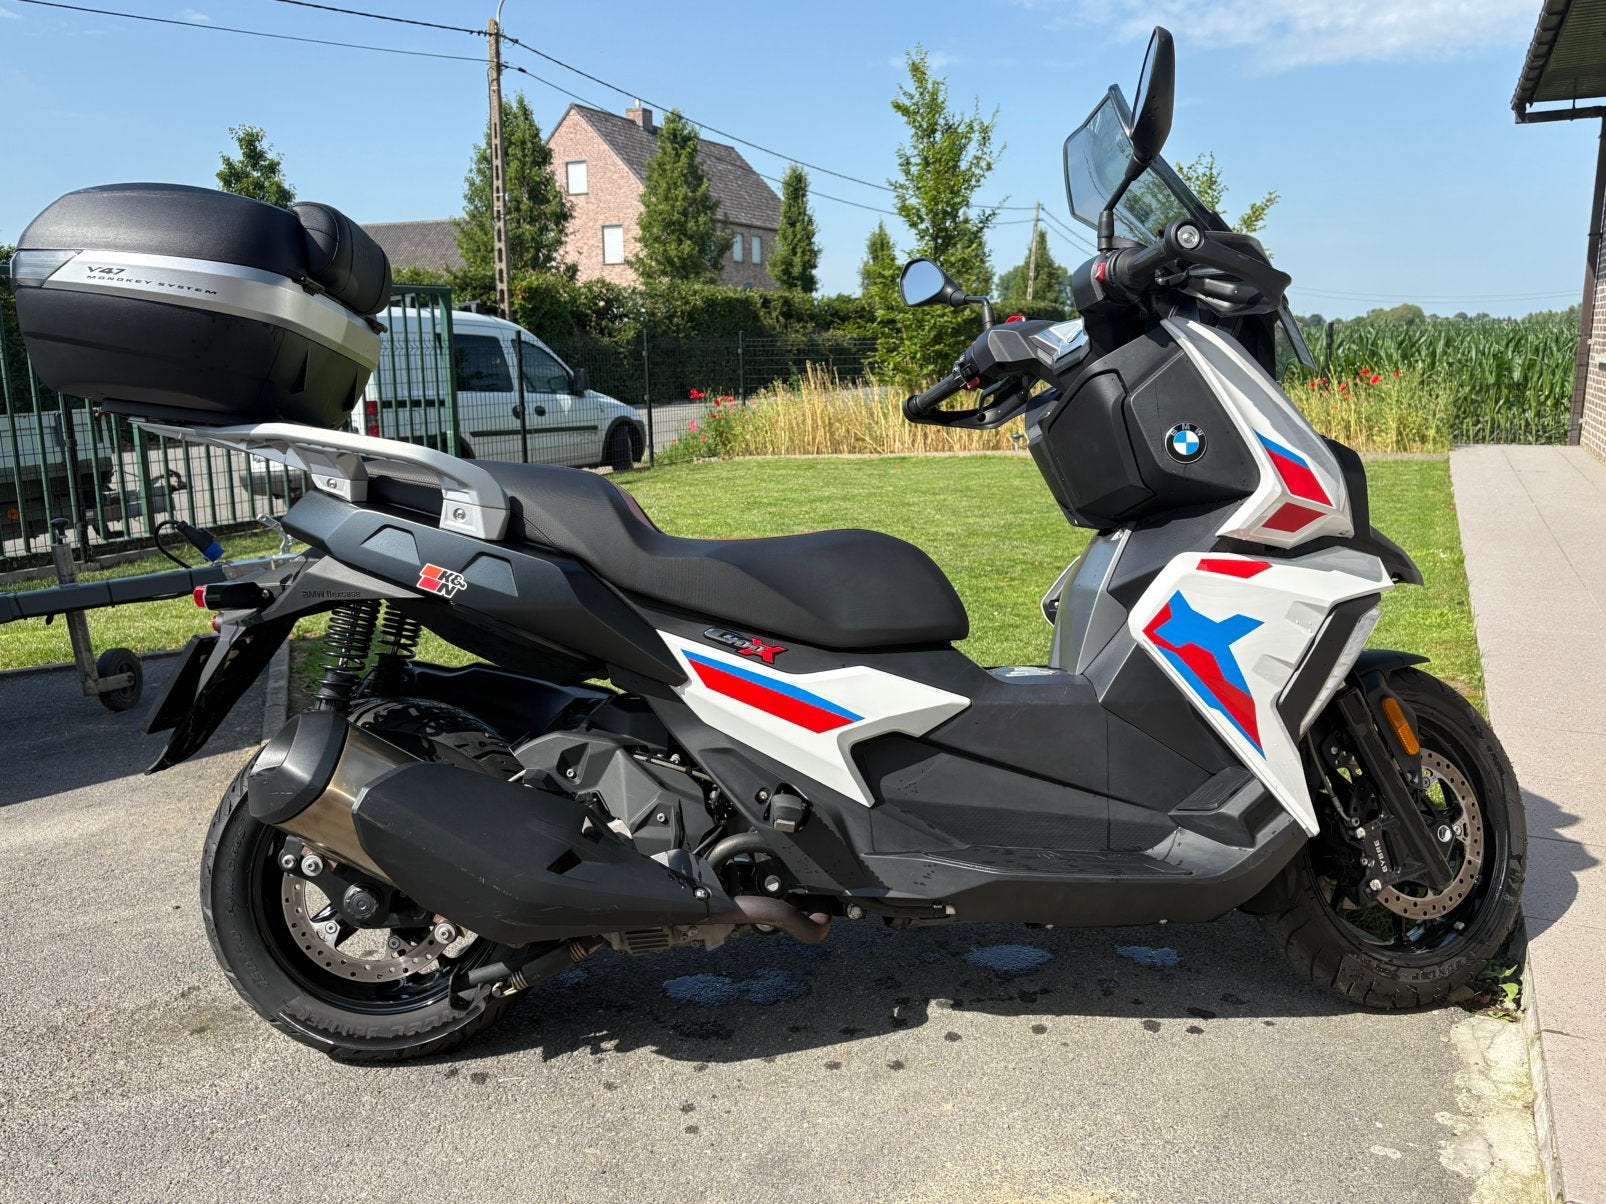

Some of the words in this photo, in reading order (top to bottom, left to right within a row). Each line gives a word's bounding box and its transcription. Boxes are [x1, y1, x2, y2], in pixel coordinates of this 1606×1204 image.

[87, 265, 125, 275] V47
[86, 275, 152, 285] MONOKEY
[158, 282, 217, 295] SYSTEM
[302, 590, 325, 598] BMW
[1373, 839, 1388, 873] BYBRE
